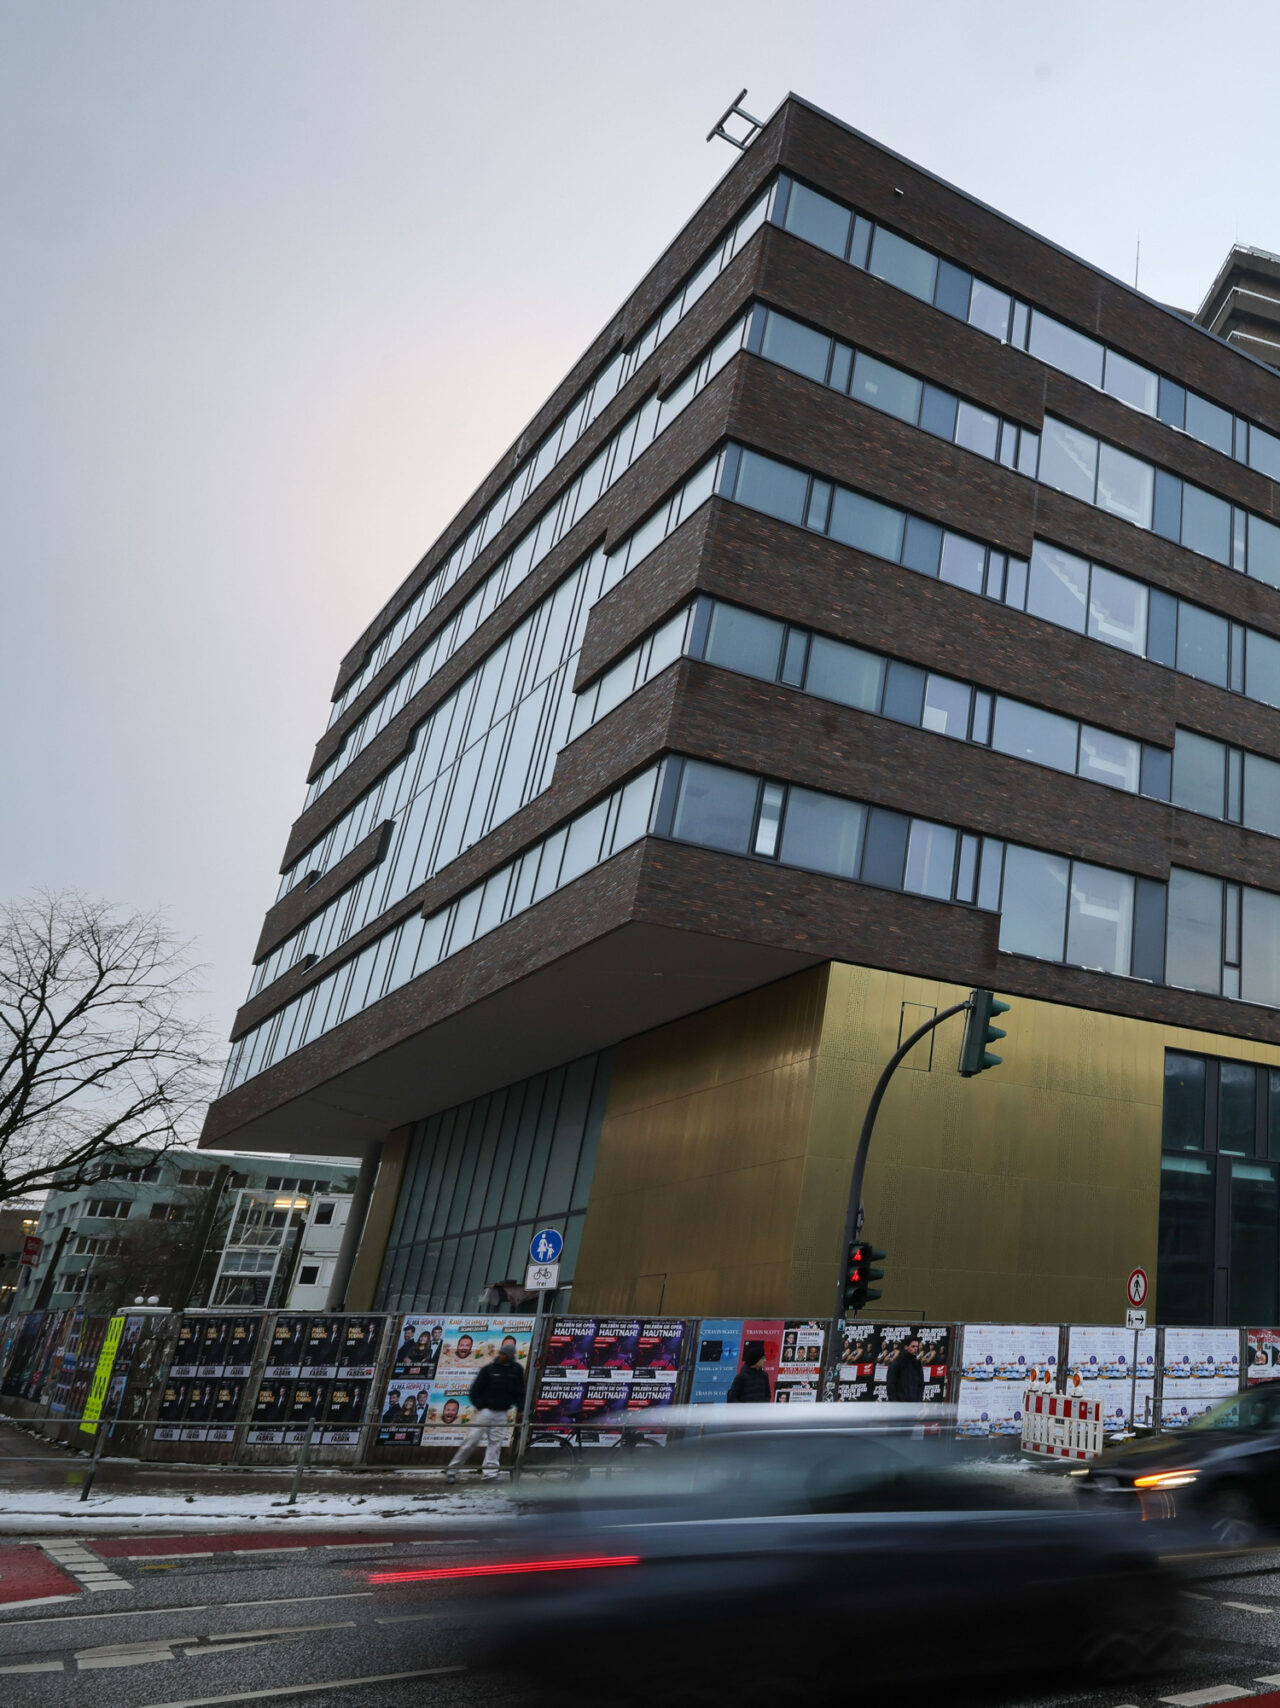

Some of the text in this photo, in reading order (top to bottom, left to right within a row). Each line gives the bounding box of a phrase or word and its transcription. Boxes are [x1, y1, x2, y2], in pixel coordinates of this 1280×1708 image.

[554, 1328, 594, 1336] HAUTNAH!
[598, 1329, 638, 1337] HAUTNAH!
[587, 1392, 628, 1400] HAUTNAH!
[631, 1392, 671, 1400] HAUTNAH!
